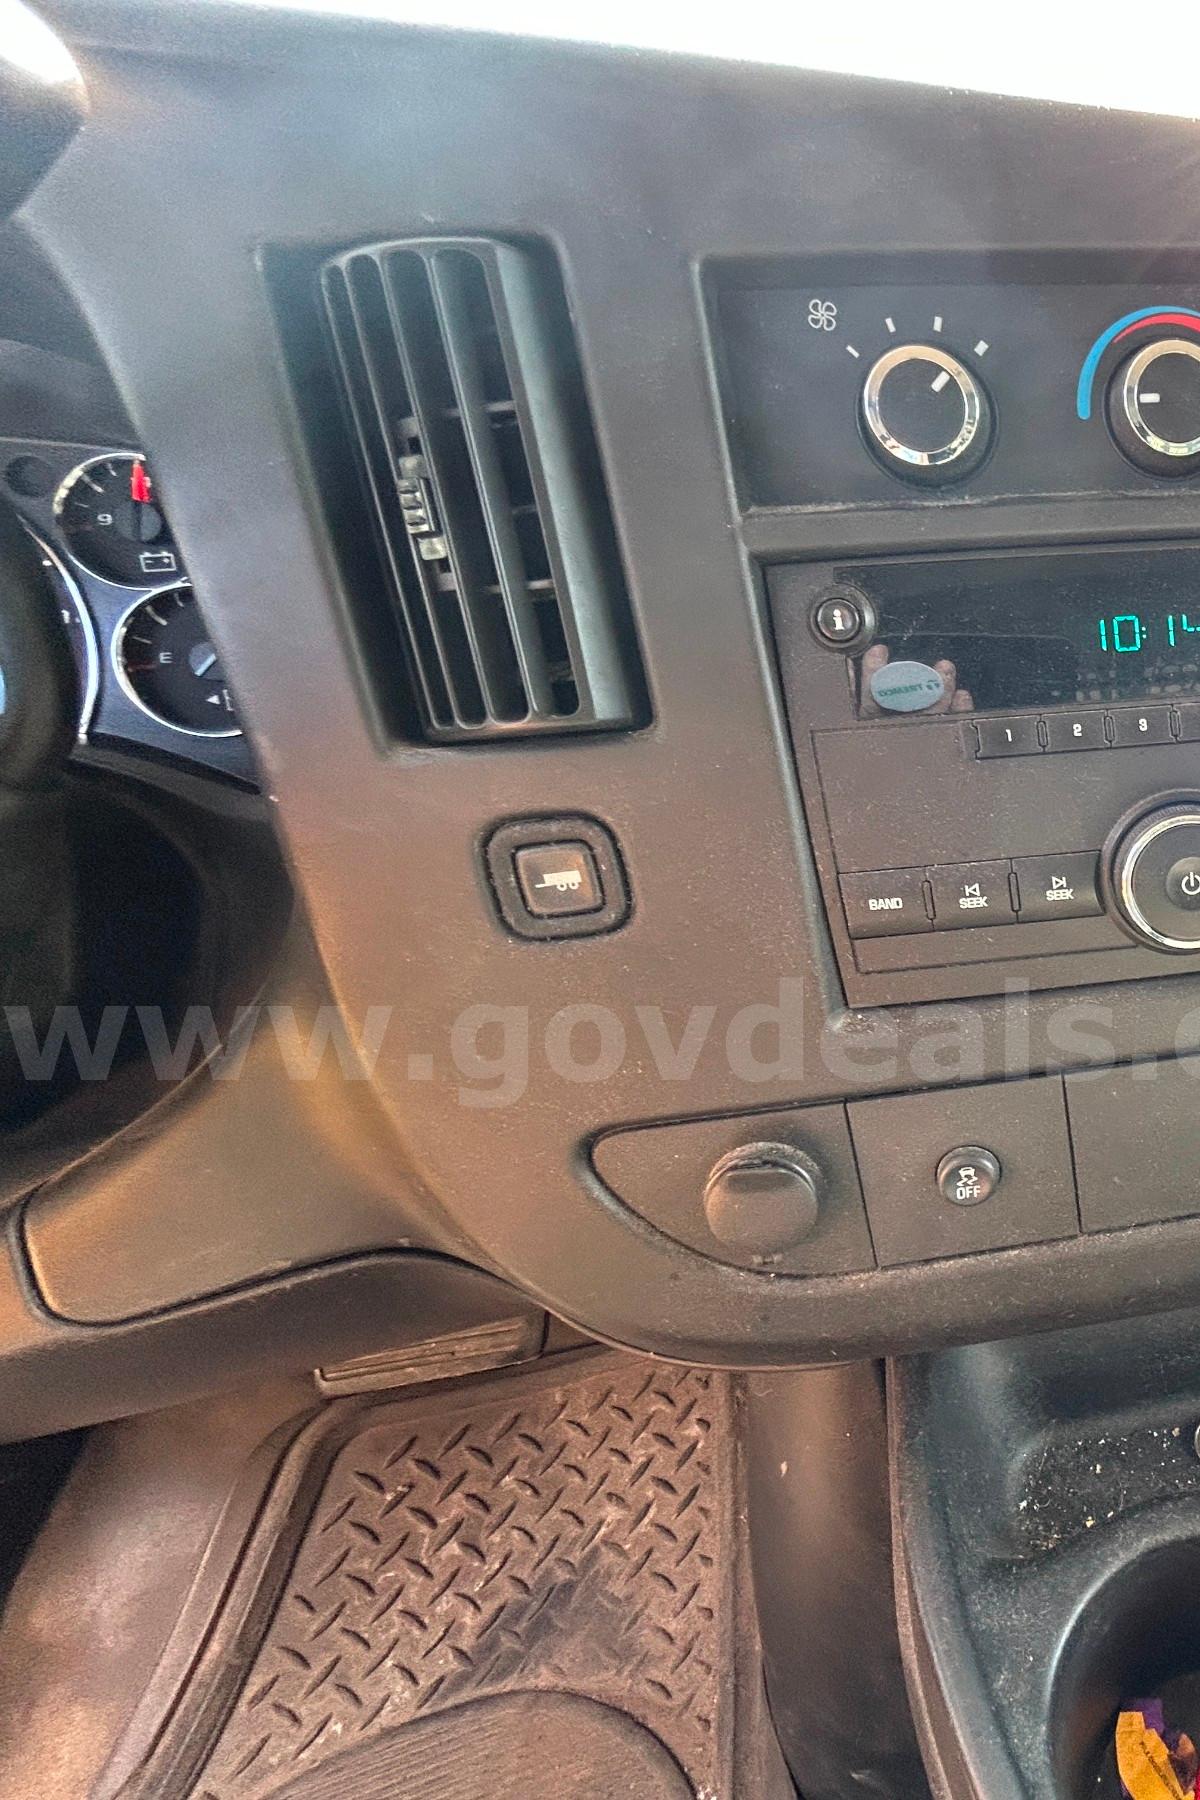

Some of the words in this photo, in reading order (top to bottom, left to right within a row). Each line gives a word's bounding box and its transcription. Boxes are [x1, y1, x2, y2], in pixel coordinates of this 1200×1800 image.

[97, 513, 113, 526] 9
[159, 652, 173, 664] E
[1005, 728, 1013, 742] 1
[1072, 723, 1083, 738] 2
[1138, 718, 1148, 732] 3
[1045, 888, 1075, 902] SEEK
[868, 897, 904, 912] BAND
[959, 896, 989, 909] SEEK
[956, 1185, 982, 1200] OFF
